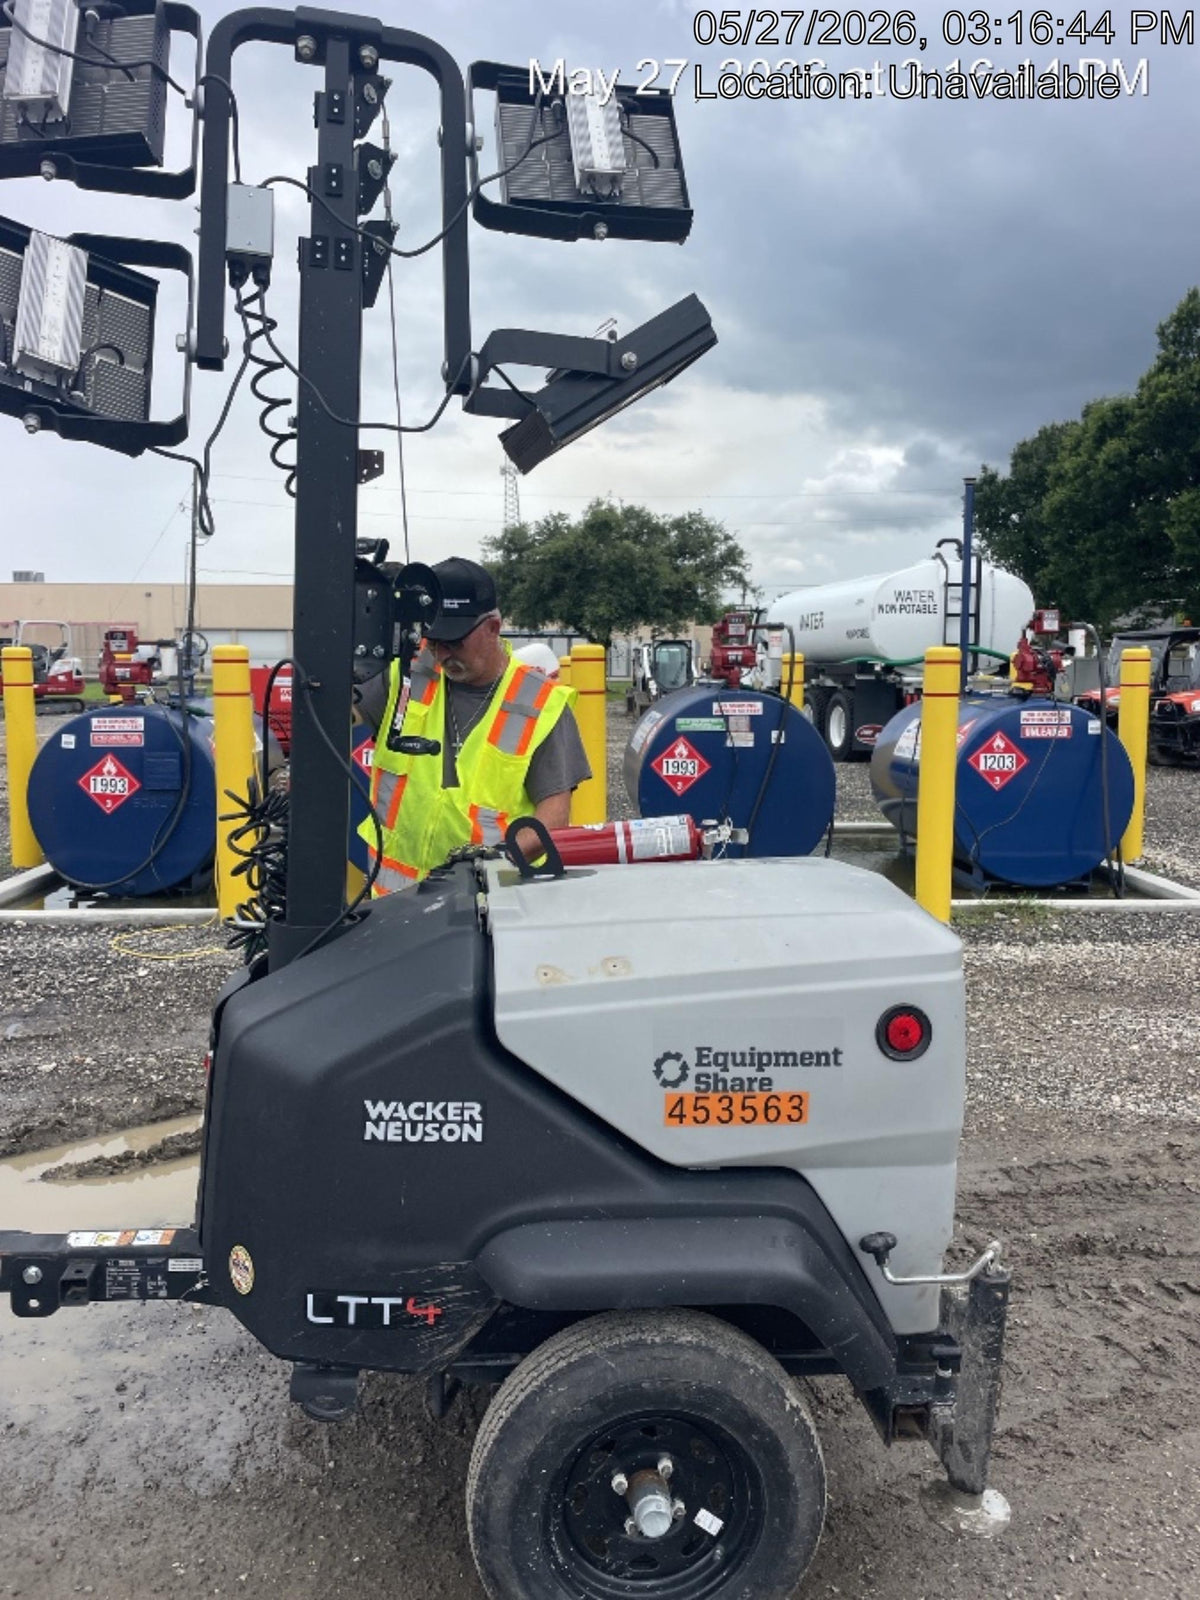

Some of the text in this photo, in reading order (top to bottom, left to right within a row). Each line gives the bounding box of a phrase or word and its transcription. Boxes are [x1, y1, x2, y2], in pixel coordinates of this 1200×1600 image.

[894, 589, 935, 603] WATER
[664, 760, 697, 777] 1993
[983, 754, 1015, 771] 1203
[91, 777, 127, 794] 1993
[694, 1047, 843, 1072] Equipment
[694, 1073, 773, 1093] Share
[364, 1100, 483, 1121] WACKER
[668, 1094, 804, 1124] 453563
[364, 1121, 483, 1142] NEUSON
[307, 1293, 442, 1325] LTT4
